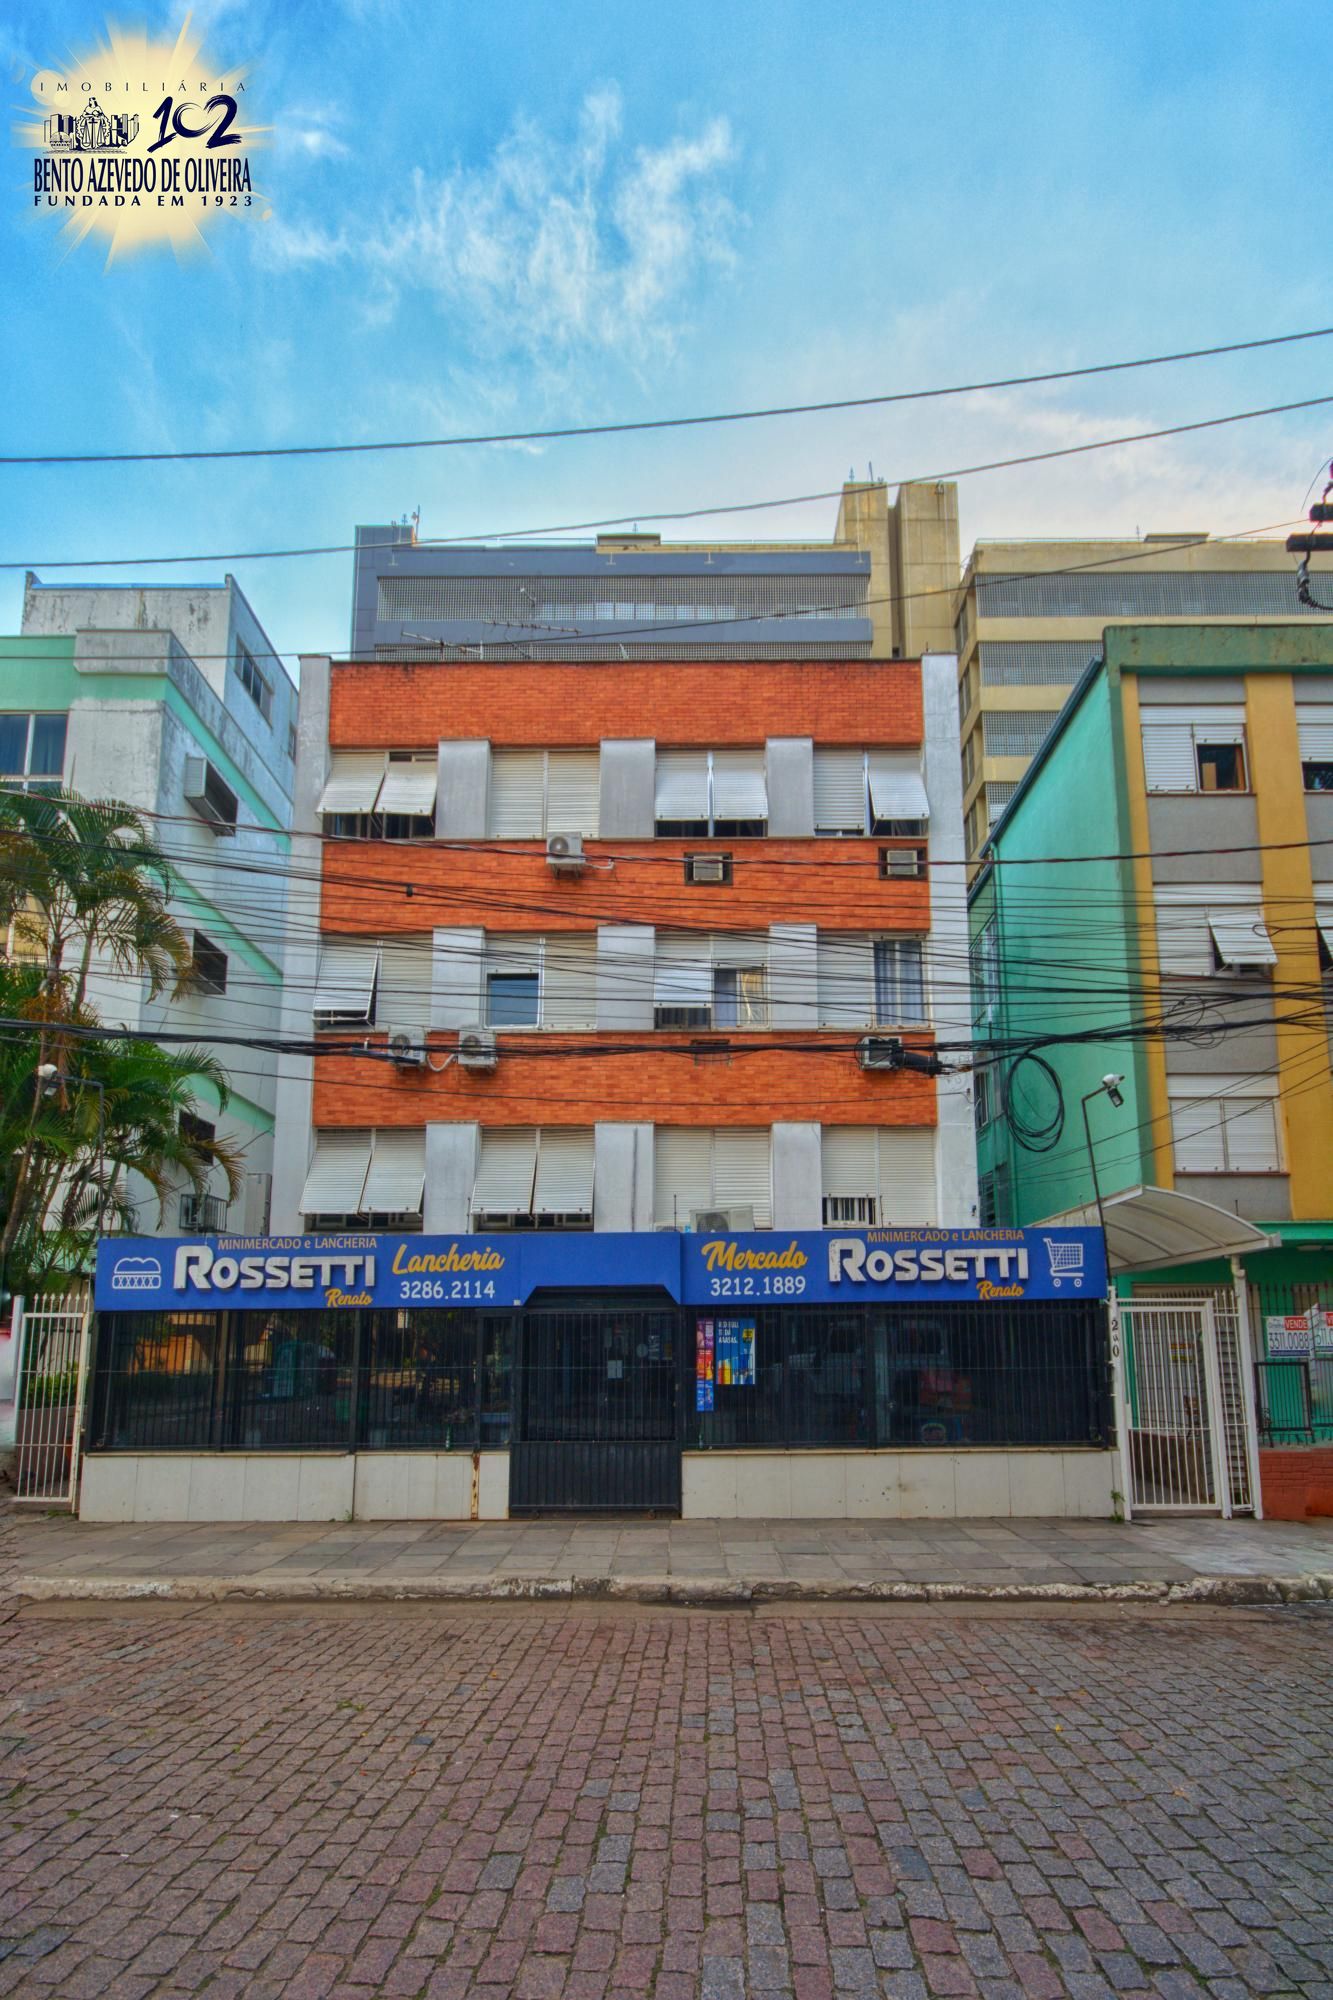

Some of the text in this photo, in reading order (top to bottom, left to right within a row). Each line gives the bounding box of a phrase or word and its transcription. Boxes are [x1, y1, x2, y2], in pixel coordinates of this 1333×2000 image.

[217, 1237, 378, 1250] MINIMERCADO e LANCHERIA
[867, 1230, 1025, 1243] MINIMERCADO e LANCHERIA
[392, 1243, 506, 1275] Lancheria
[701, 1240, 808, 1271] Mercado
[828, 1238, 1029, 1283] ROSSETTI
[173, 1245, 375, 1290] ROSSETTI
[399, 1280, 496, 1300] 3286.2114
[709, 1276, 806, 1297] 3212.1889
[976, 1280, 1024, 1300] Renato
[324, 1288, 373, 1307] Renato
[1286, 1319, 1308, 1329] VENDE
[1269, 1332, 1310, 1349] 3311.0088
